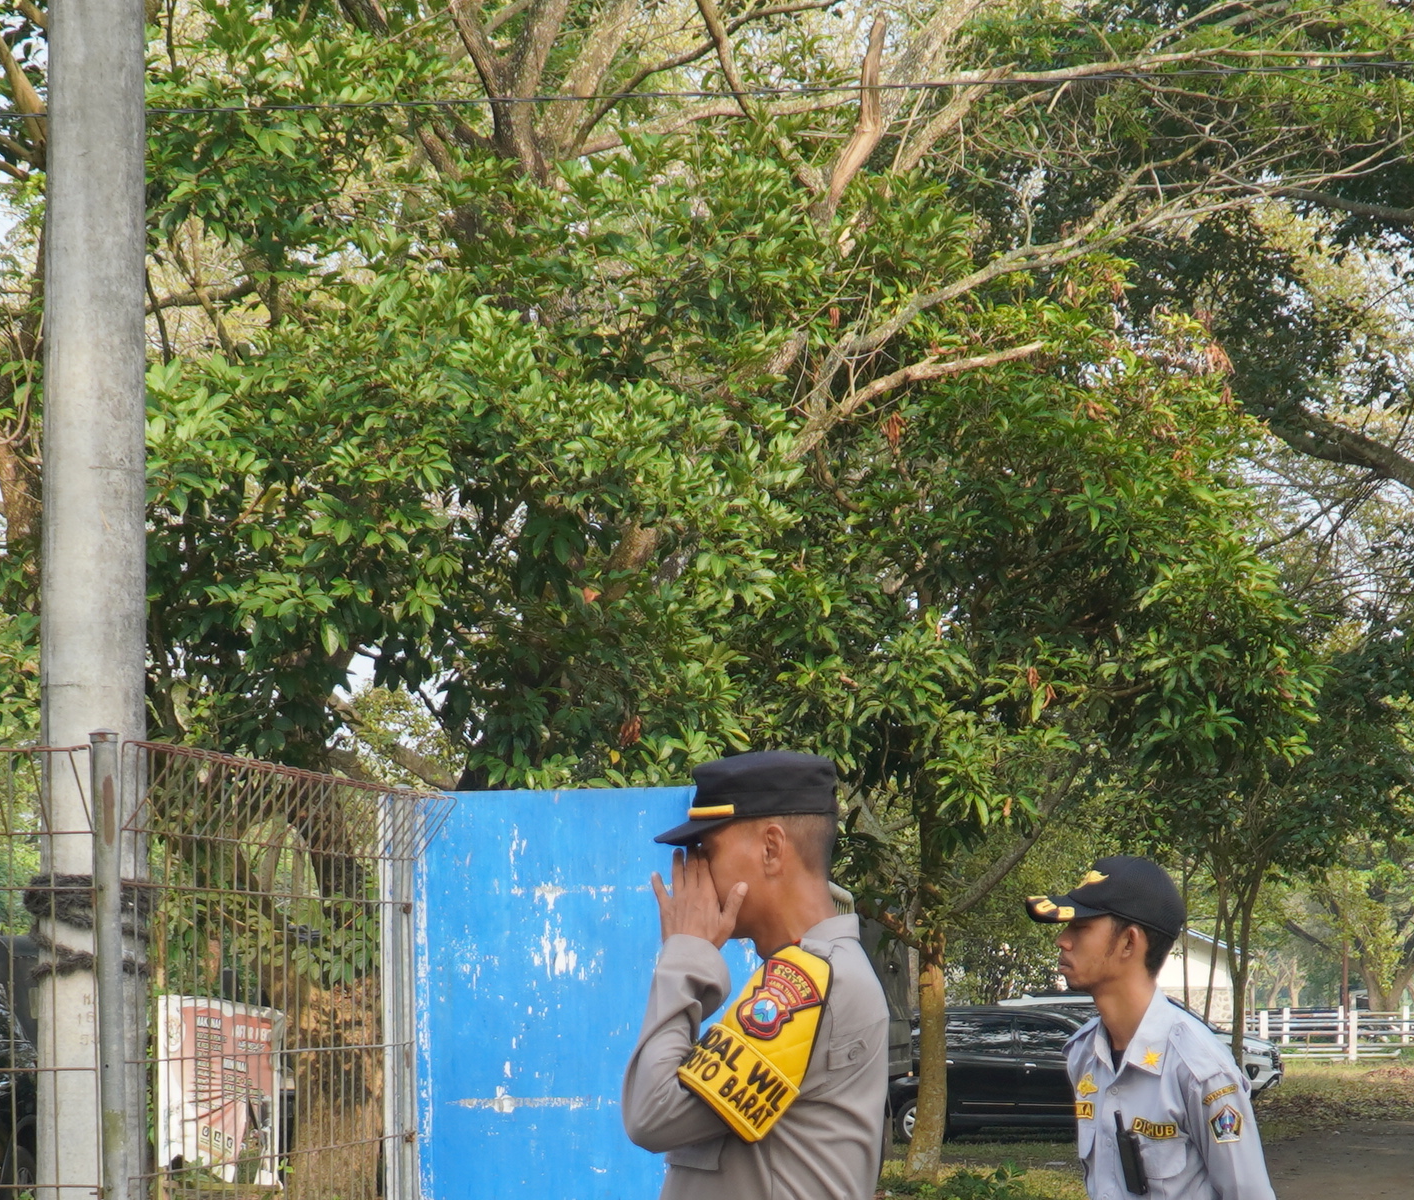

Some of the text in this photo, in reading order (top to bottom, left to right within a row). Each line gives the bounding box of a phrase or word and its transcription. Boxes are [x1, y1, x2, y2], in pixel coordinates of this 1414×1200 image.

[776, 964, 812, 994] POLRES
[699, 1027, 790, 1113] DAL WIL
[718, 1074, 775, 1130] BARAT
